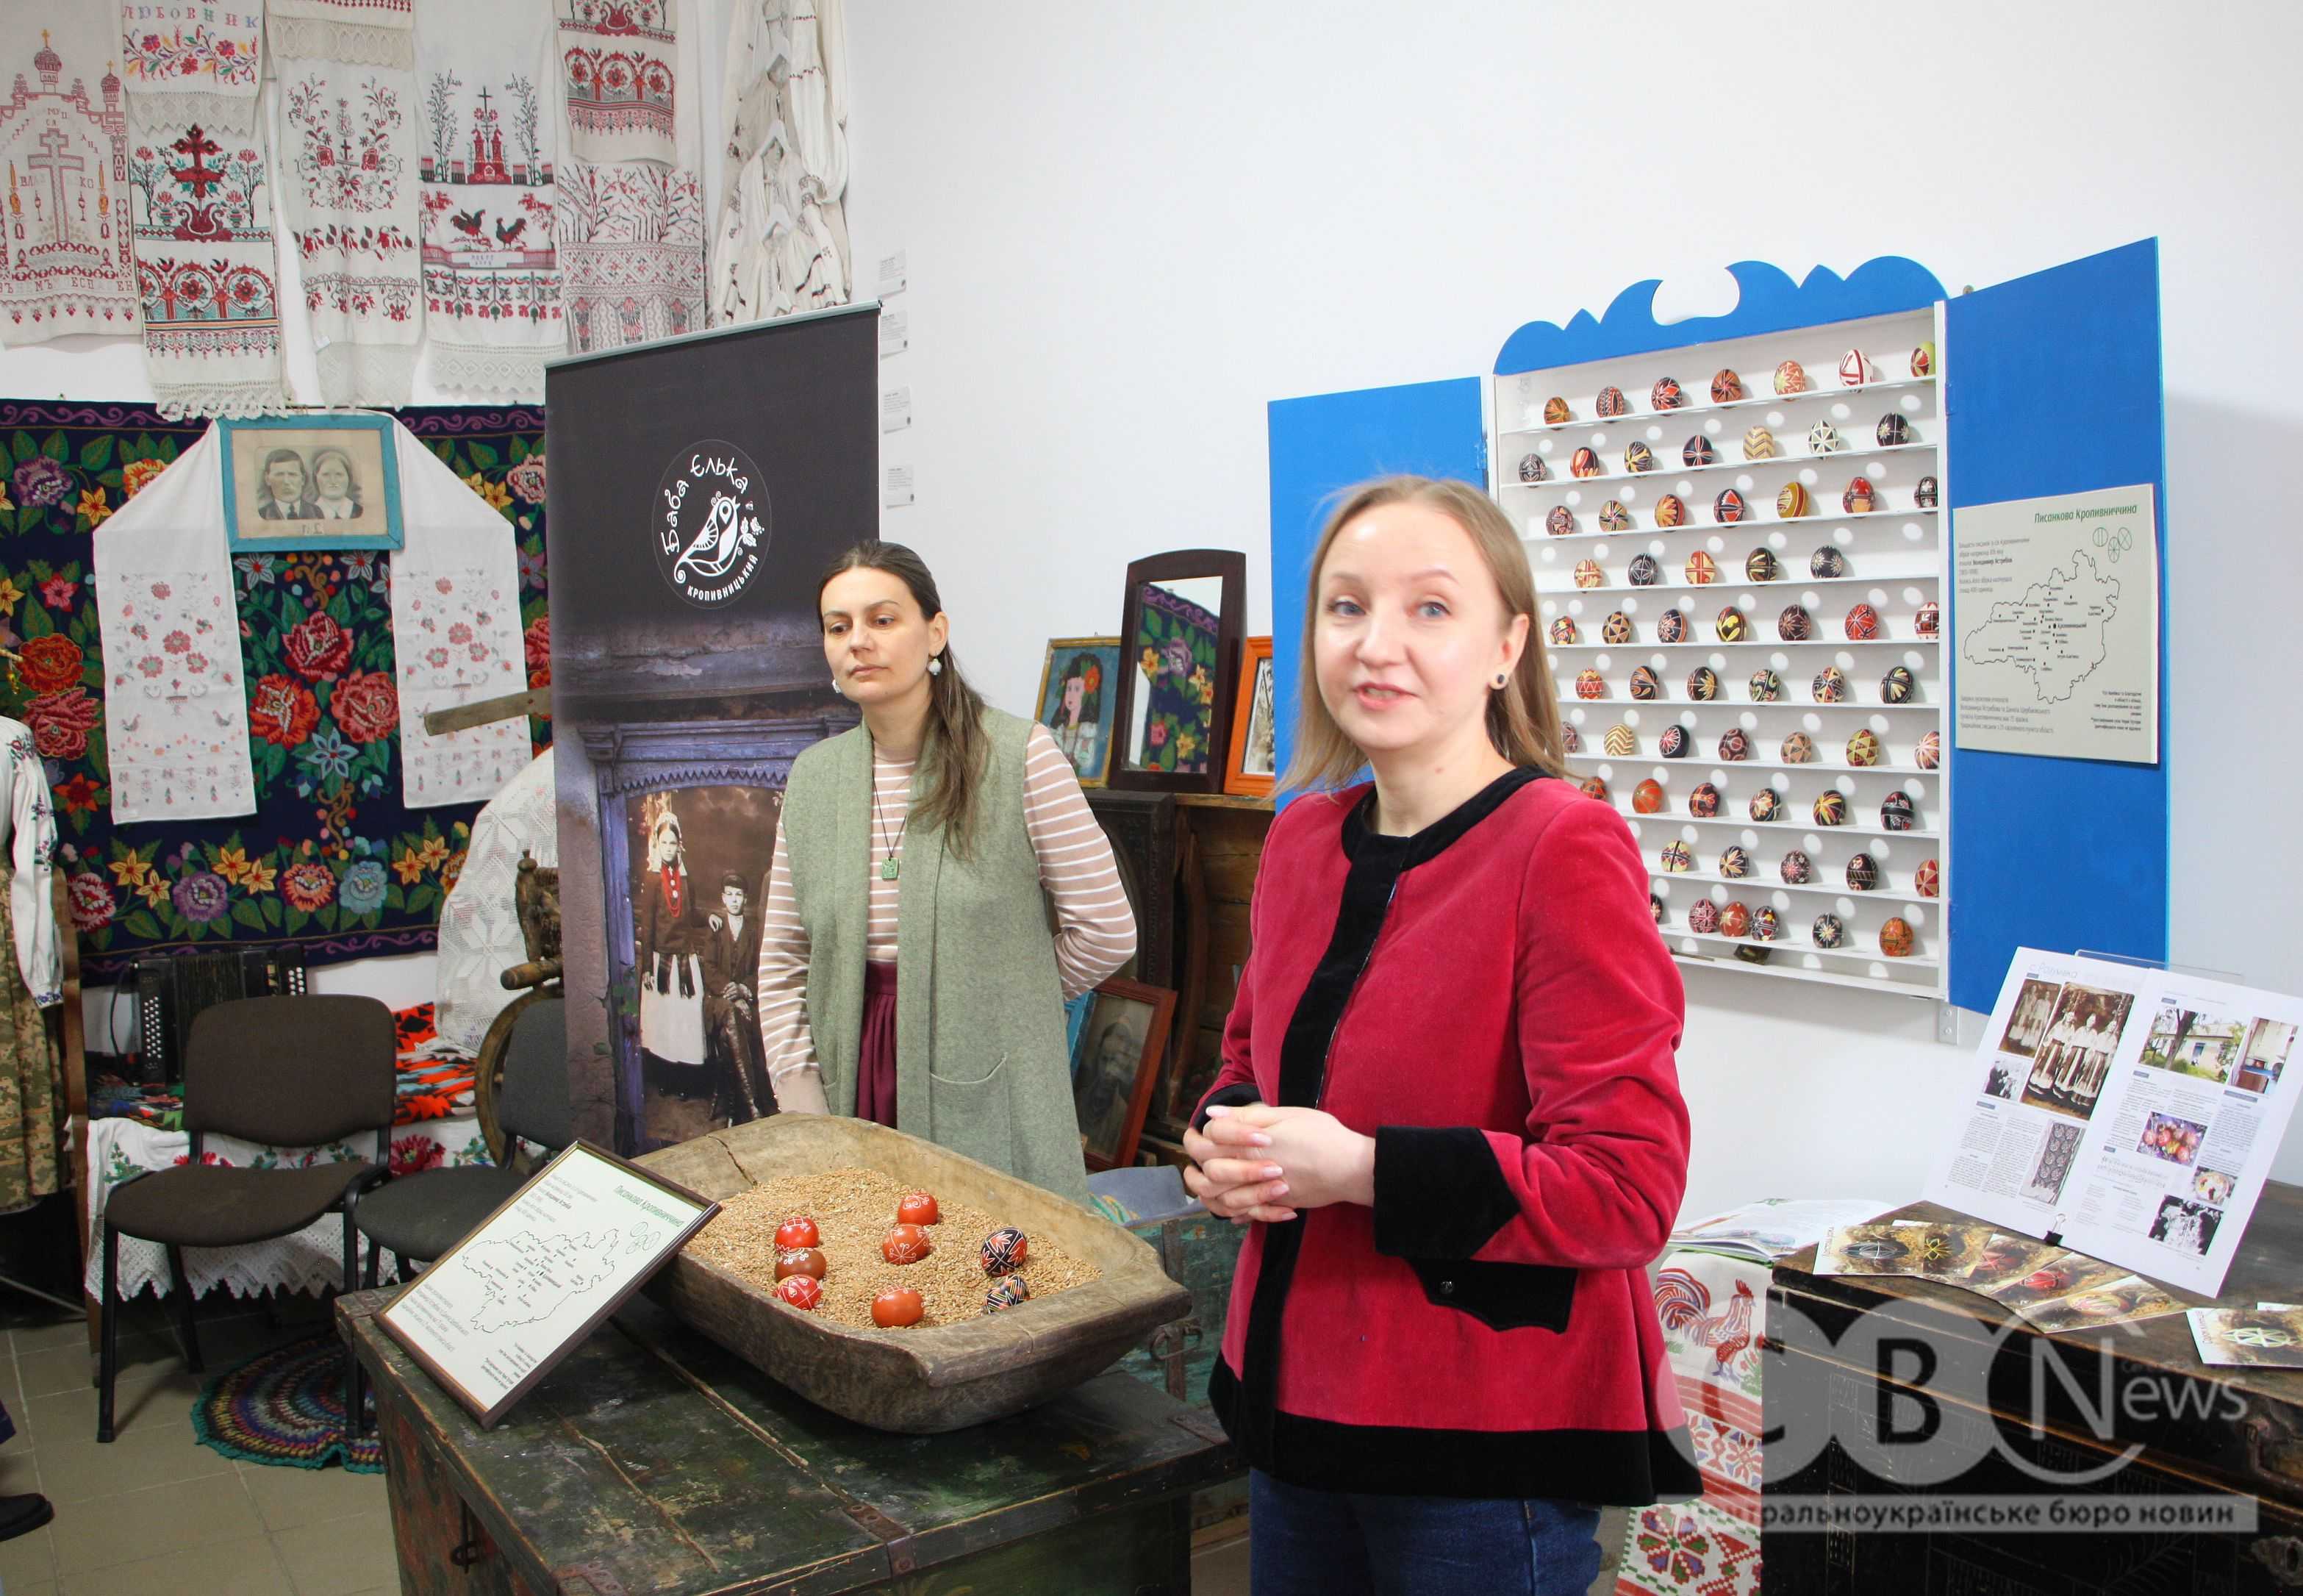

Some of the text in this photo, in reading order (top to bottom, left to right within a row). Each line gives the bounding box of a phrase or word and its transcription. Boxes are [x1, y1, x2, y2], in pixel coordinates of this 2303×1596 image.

[661, 479, 689, 555] Баба
[2034, 504, 2138, 523] Писанкова Кропивниччина
